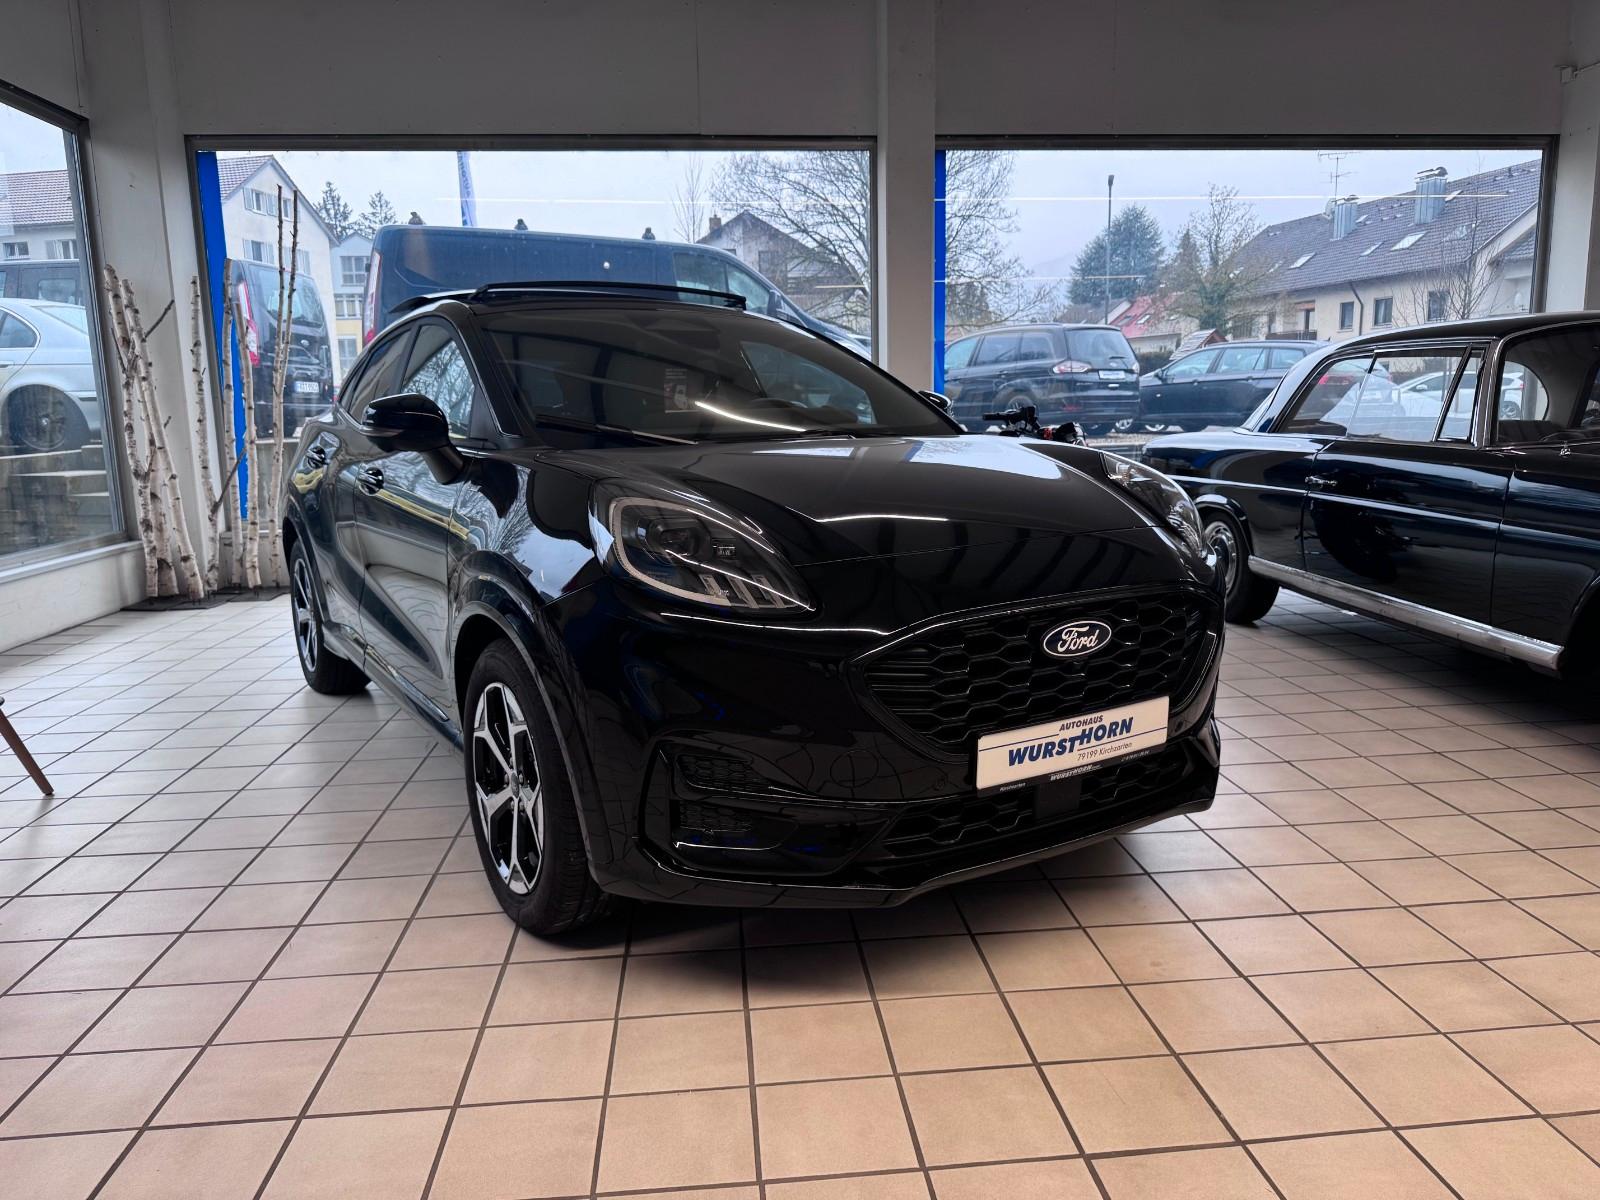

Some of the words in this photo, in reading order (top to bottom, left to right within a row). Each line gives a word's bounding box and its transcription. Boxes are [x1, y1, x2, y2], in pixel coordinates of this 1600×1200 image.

[1057, 625, 1100, 652] Ford
[1059, 715, 1103, 731] AUTOHAUS
[1008, 717, 1134, 766] WURSTHORN
[1077, 749, 1098, 761] 79199
[1099, 742, 1133, 756] Kirchzarten
